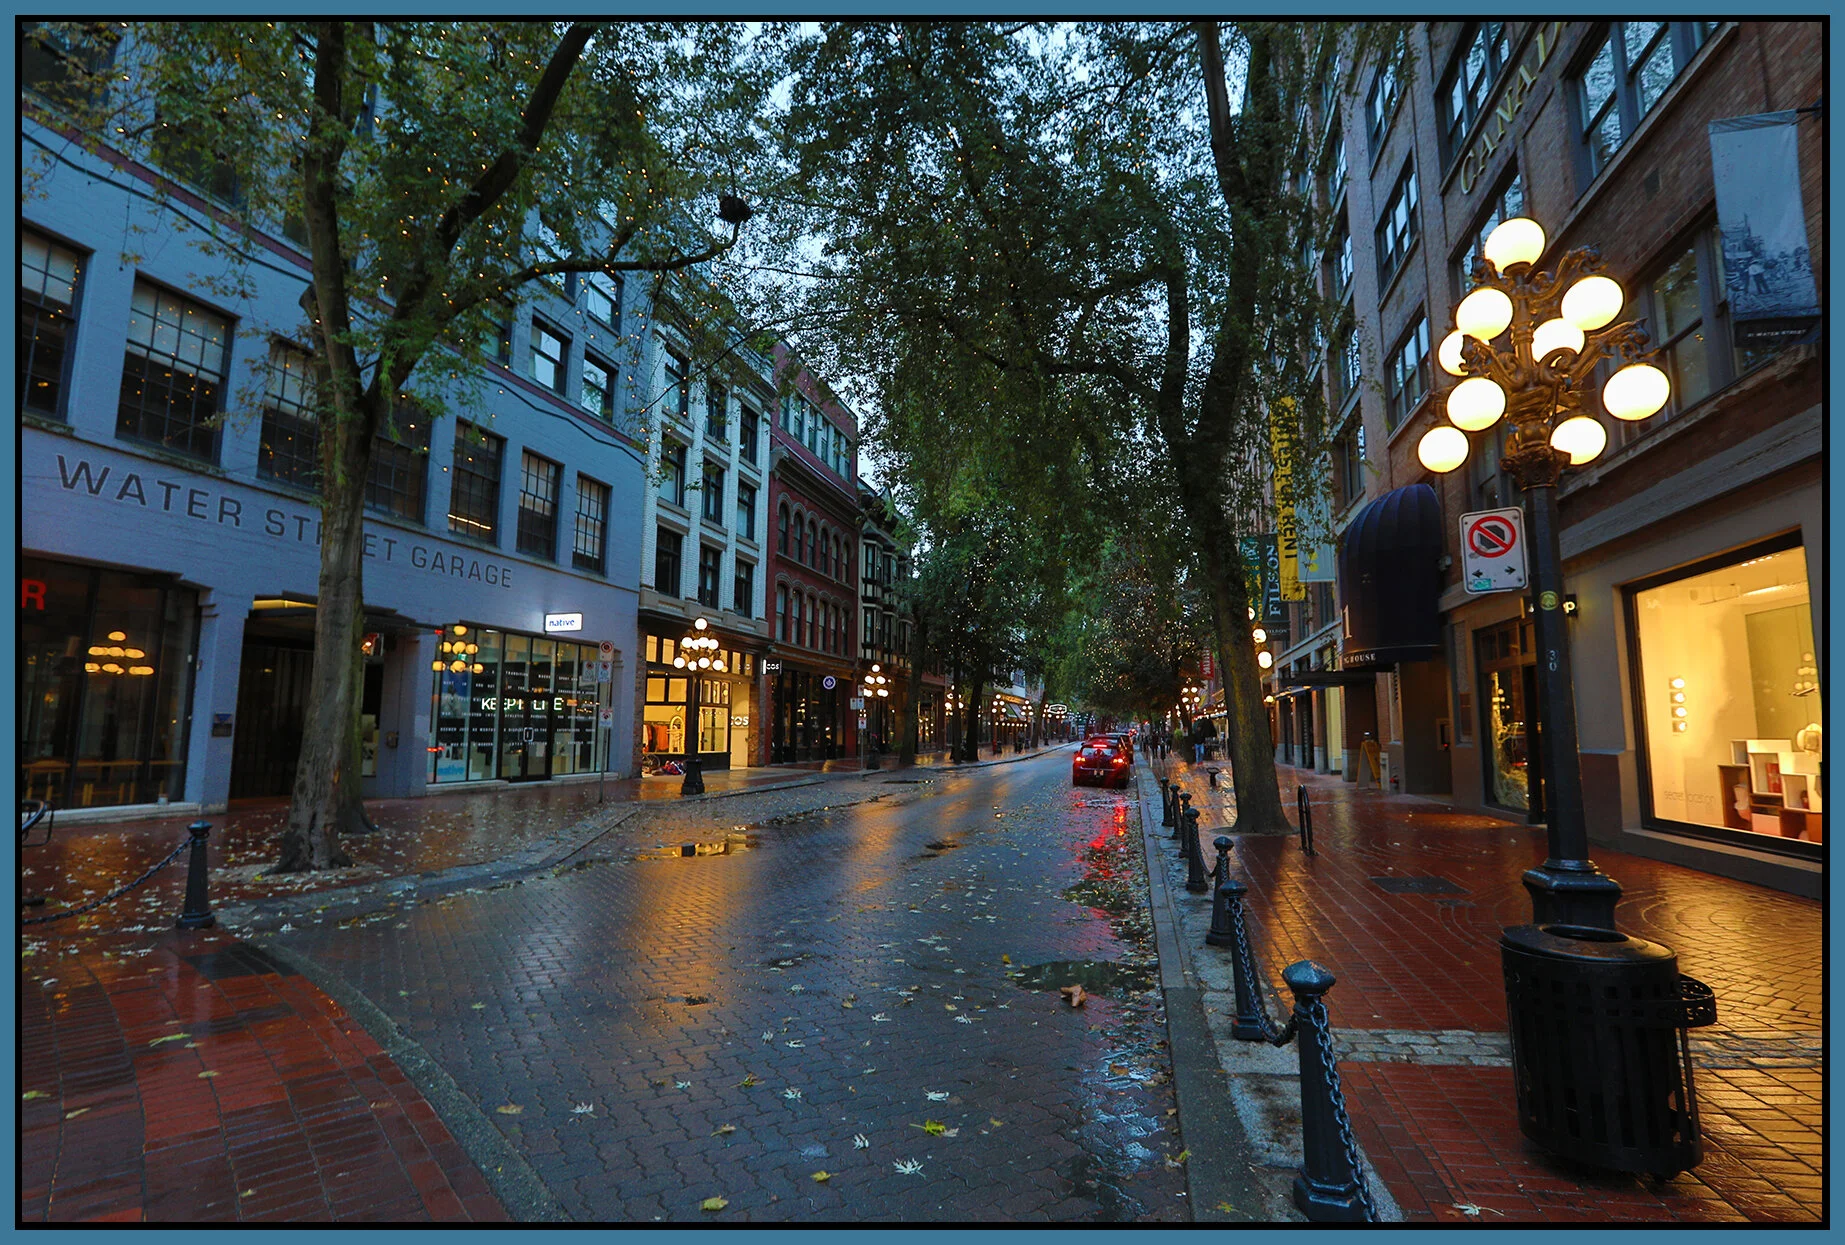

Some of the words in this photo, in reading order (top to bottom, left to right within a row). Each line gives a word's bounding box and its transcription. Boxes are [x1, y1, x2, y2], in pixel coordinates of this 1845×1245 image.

[1460, 22, 1569, 195] CANAD
[56, 454, 243, 528] WATER
[264, 508, 398, 562] STET
[411, 545, 513, 589] GARAGE
[1266, 544, 1282, 617] FILSON
[549, 618, 575, 627] native
[533, 697, 564, 711] LIE
